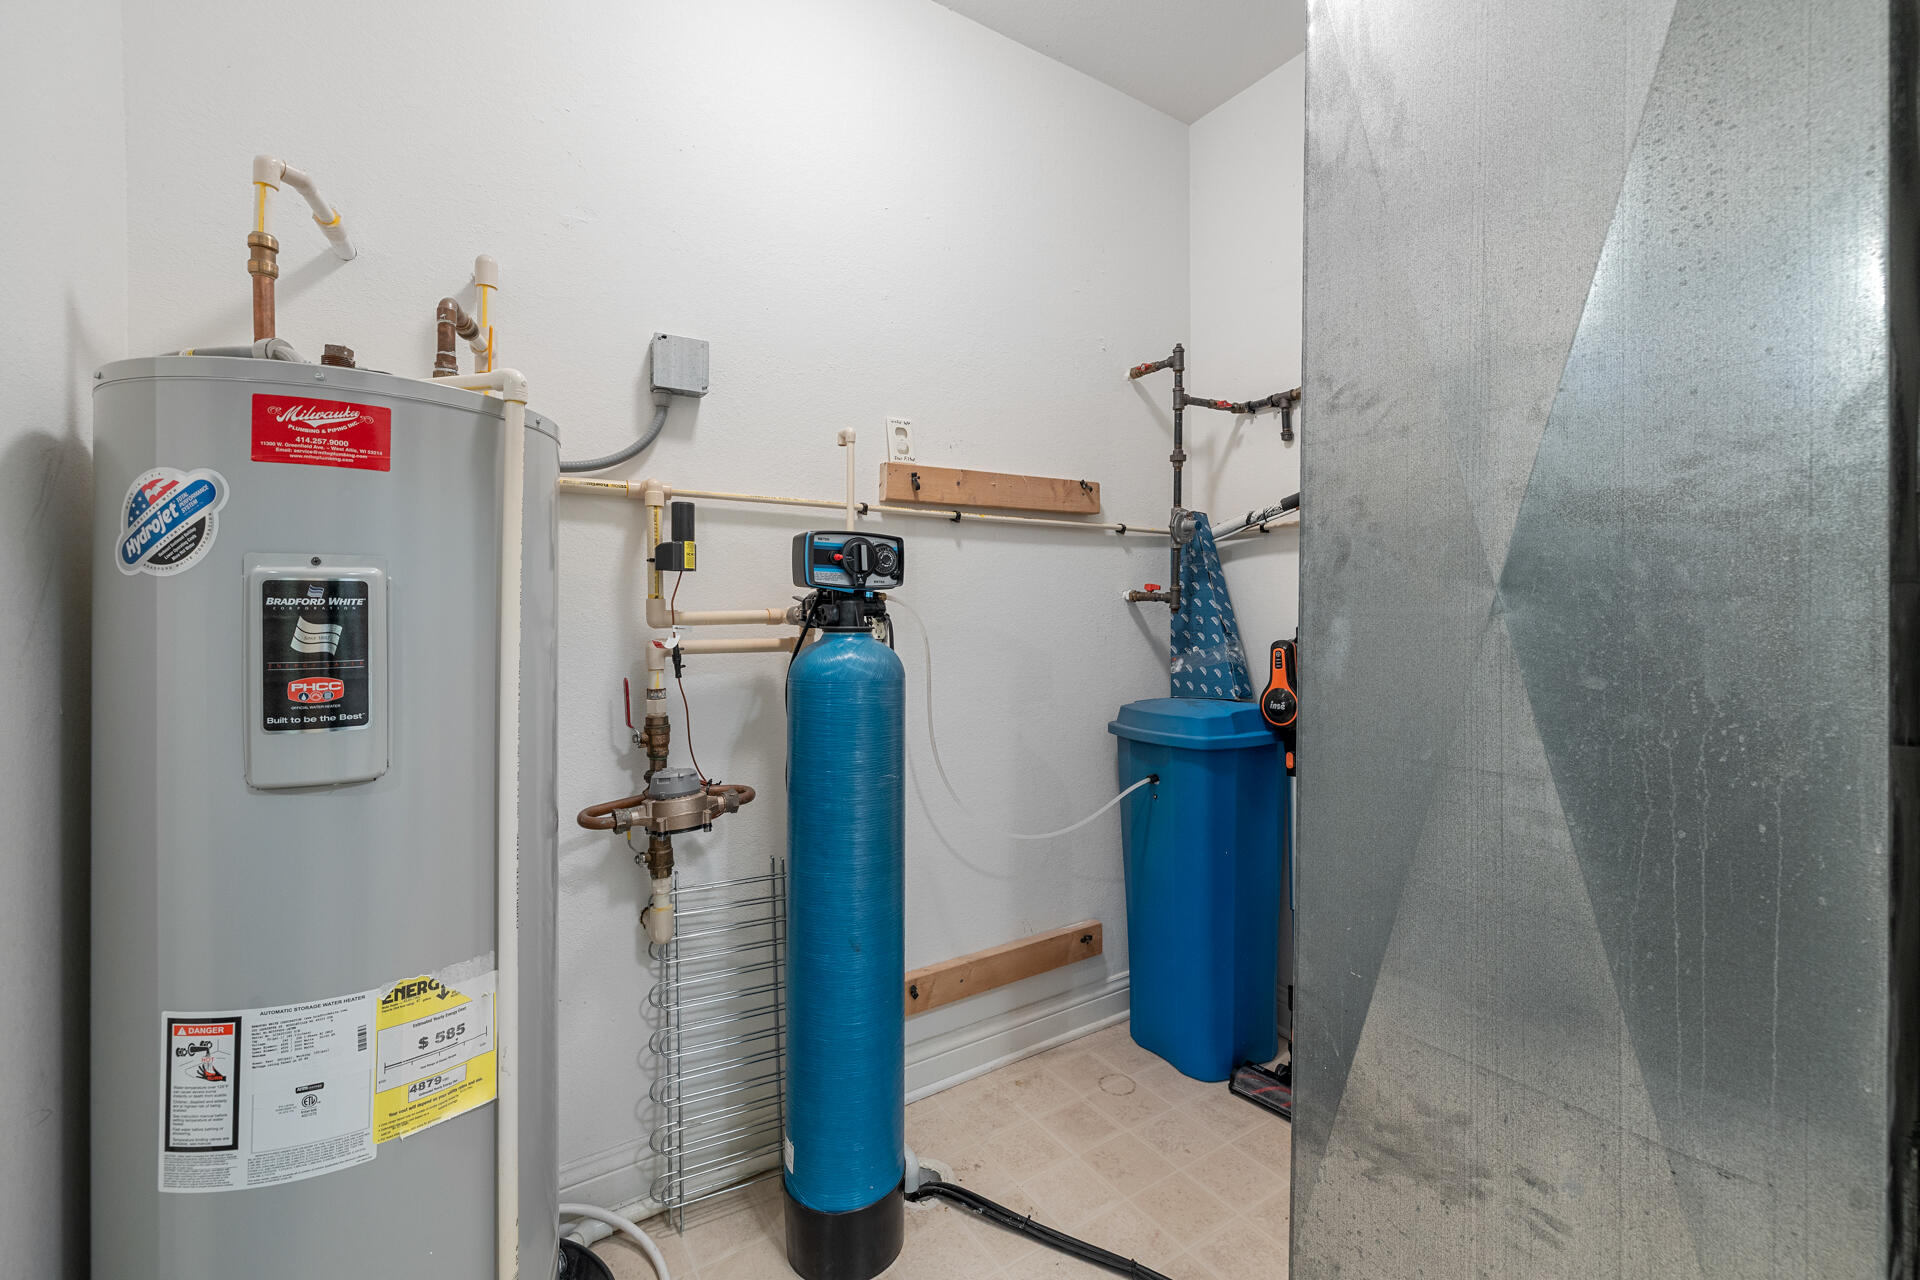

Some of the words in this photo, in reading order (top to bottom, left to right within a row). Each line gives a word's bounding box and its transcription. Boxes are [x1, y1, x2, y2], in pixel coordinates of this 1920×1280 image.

[276, 405, 360, 424] Milwaukee
[287, 423, 320, 434] PLUMBING
[327, 425, 348, 433] PIPING
[347, 420, 360, 430] INC.
[285, 441, 313, 449] Greenfield
[296, 436, 349, 447] 414.257.9000
[181, 499, 199, 514] SYSTEM
[125, 501, 180, 559] Hydrojet
[266, 597, 326, 606] BRADFORD
[328, 597, 363, 606] WHITE
[291, 682, 342, 692] PHCC
[290, 716, 301, 724] to
[303, 715, 317, 723] be
[320, 714, 337, 722] the
[339, 712, 363, 721] Best
[260, 1008, 292, 1016] AUTOMATIC
[294, 1003, 321, 1012] STORAGE
[322, 999, 343, 1007] WATER
[343, 995, 366, 1003] HEATER
[188, 1026, 225, 1034] DANGER
[418, 1036, 429, 1050] $
[435, 1023, 466, 1044] 585
[409, 1076, 442, 1094] 4879
[417, 1099, 431, 1108] depend
